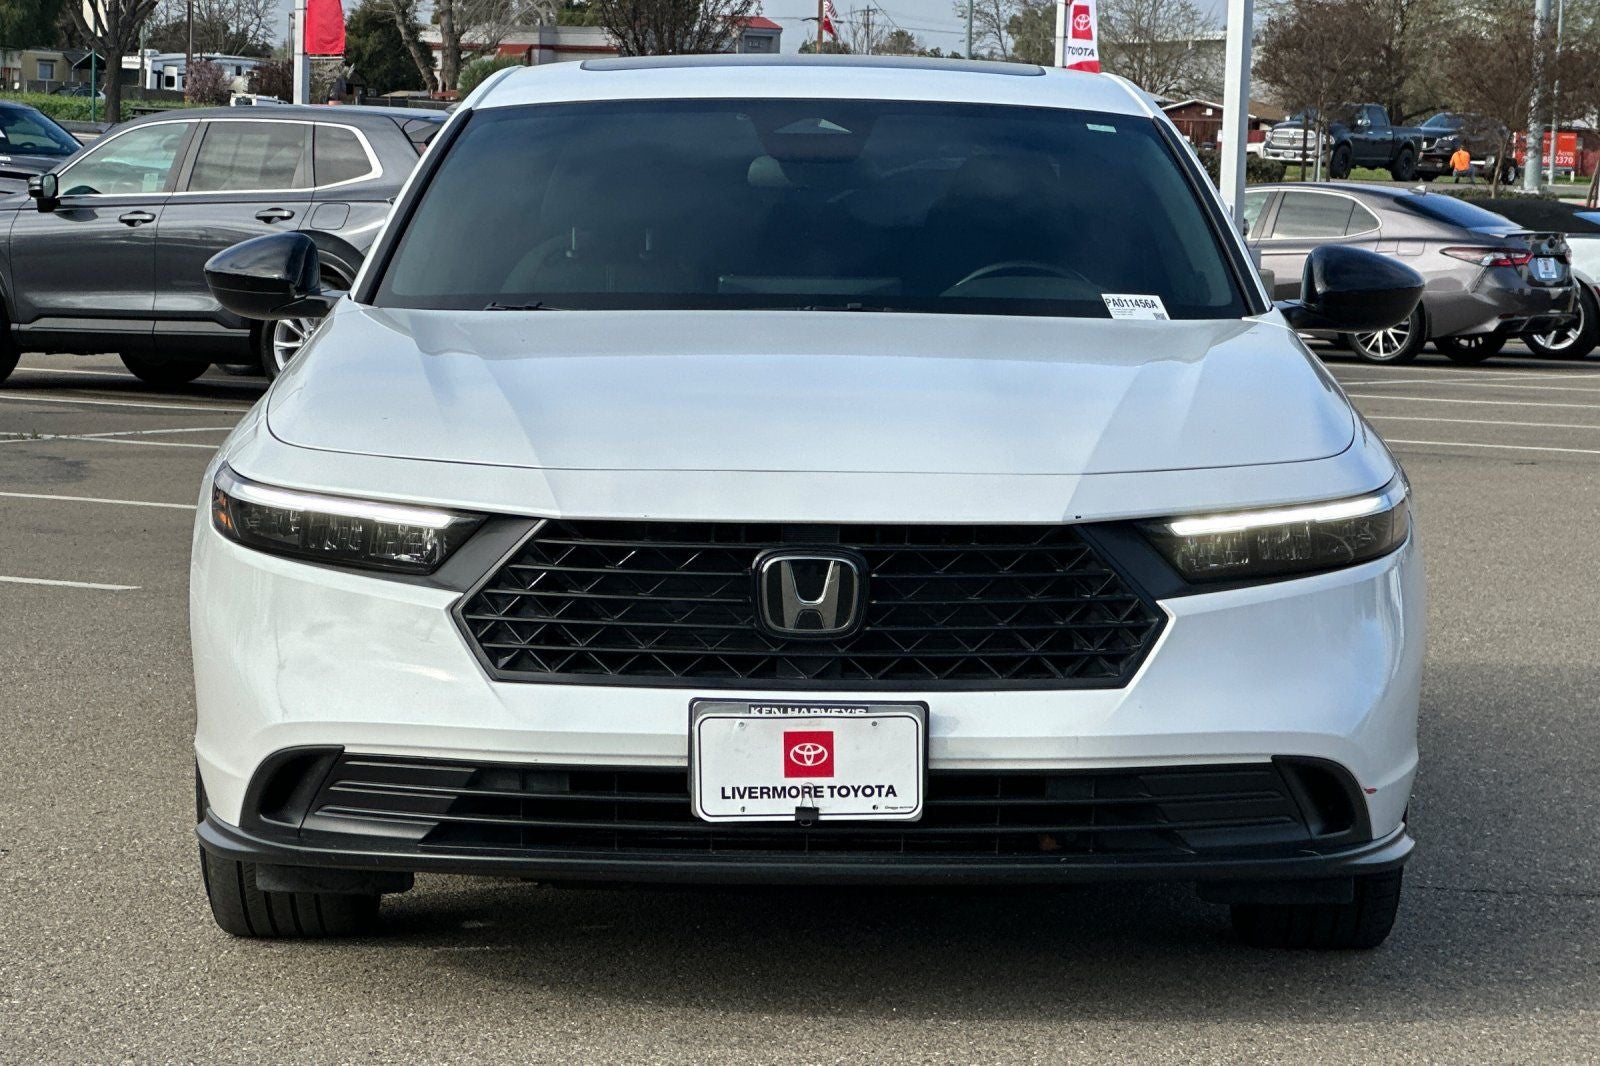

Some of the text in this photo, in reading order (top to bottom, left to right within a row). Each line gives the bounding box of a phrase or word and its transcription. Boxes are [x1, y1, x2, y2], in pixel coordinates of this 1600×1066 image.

[1067, 46, 1095, 57] TOYOTA
[1104, 298, 1158, 309] PA011456A
[750, 707, 784, 715] KEN
[720, 784, 898, 800] LIVERMORE TOYOTA
